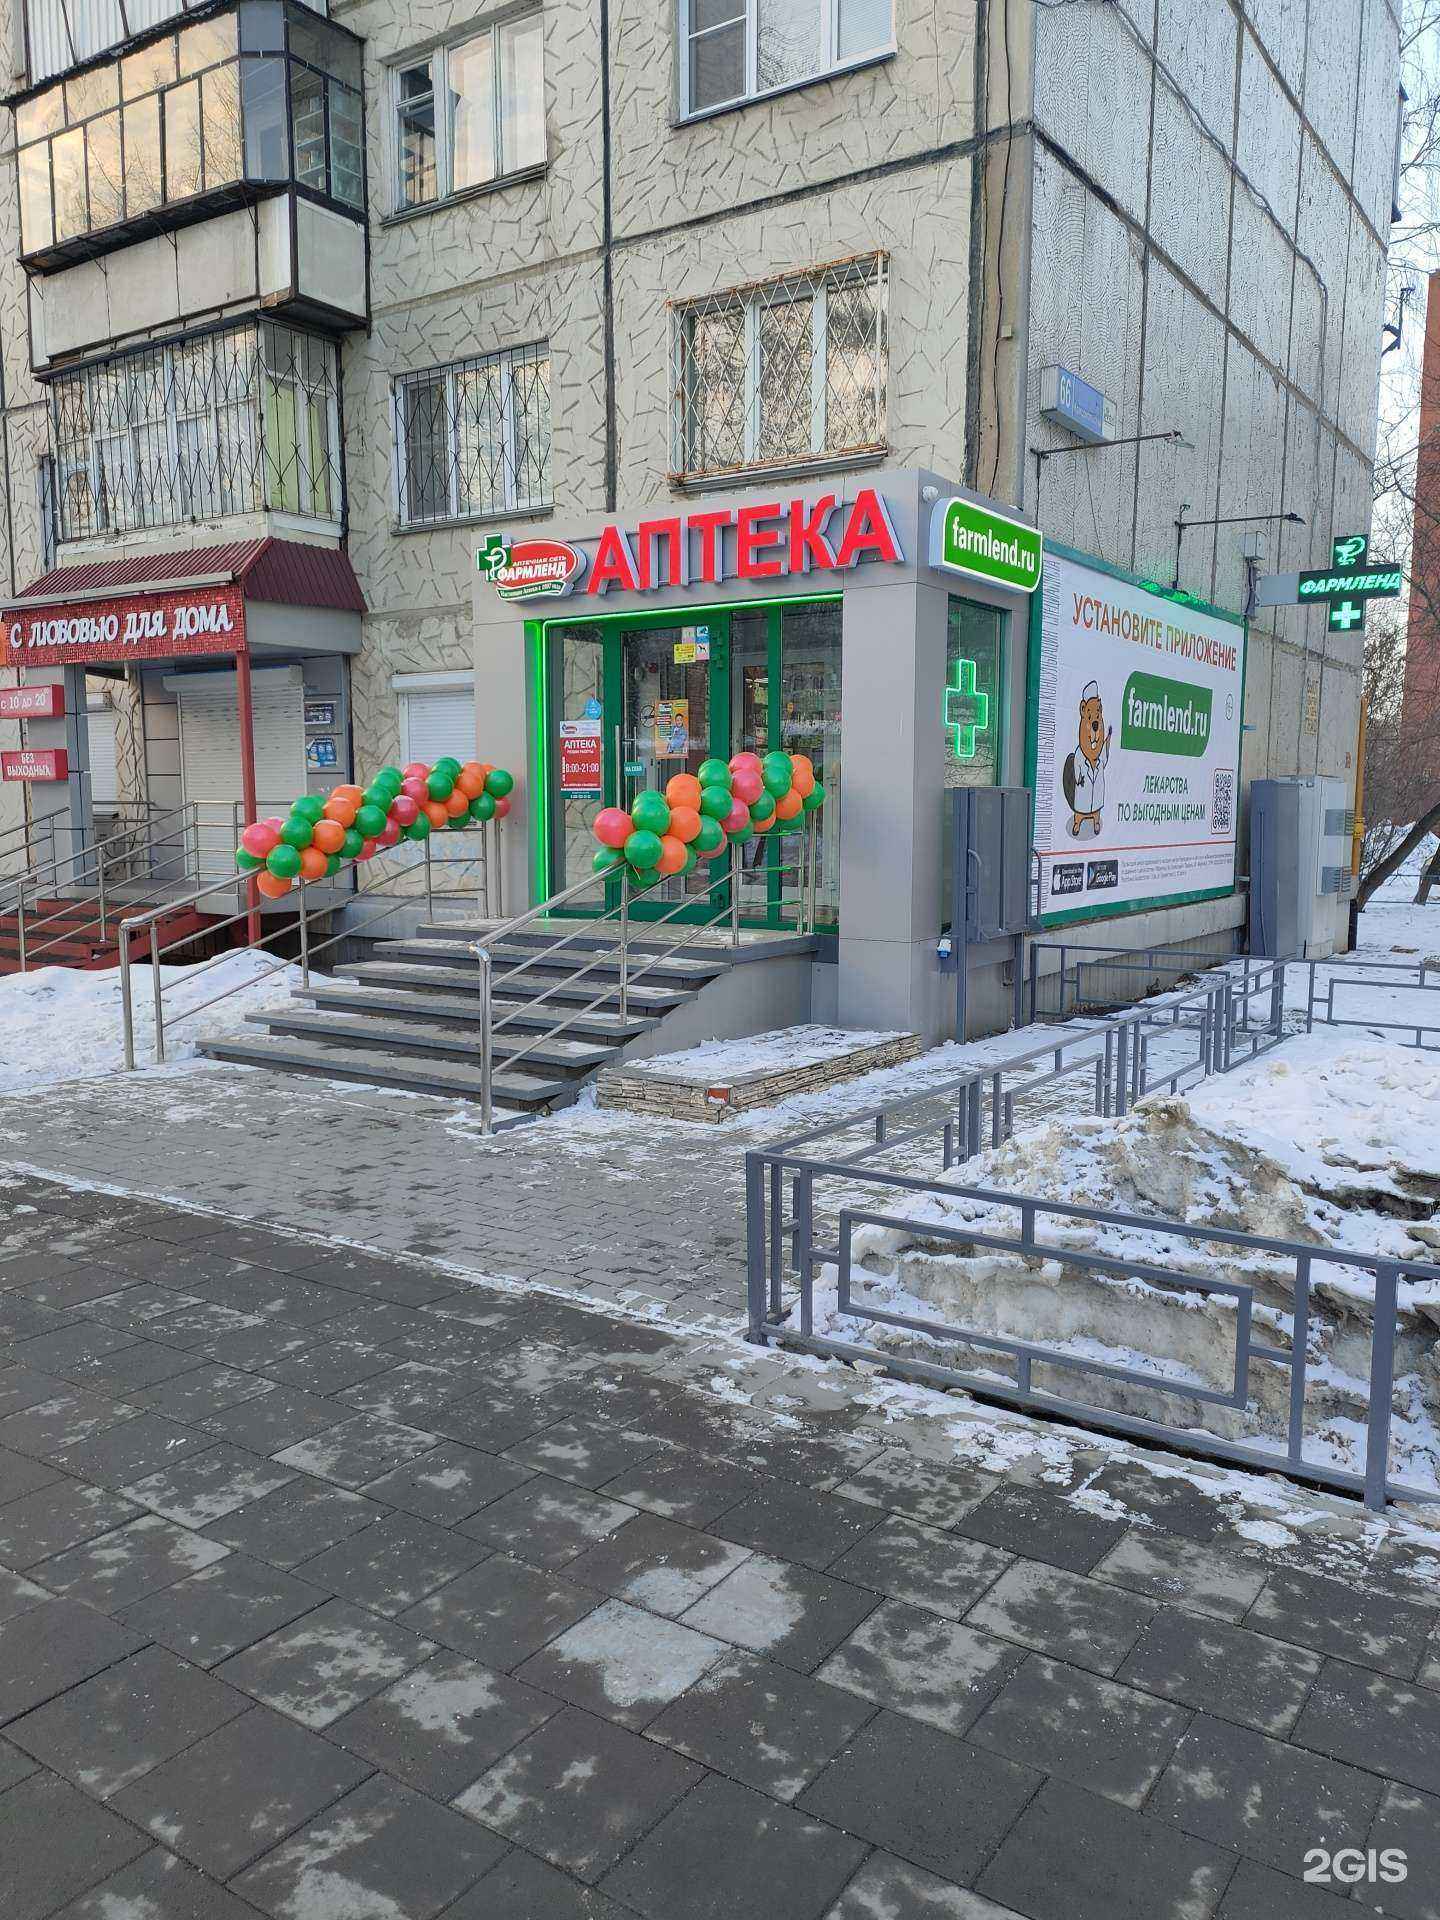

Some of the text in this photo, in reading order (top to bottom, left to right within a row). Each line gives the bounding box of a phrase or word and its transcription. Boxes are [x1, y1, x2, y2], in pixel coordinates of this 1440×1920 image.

[1060, 376, 1072, 408] 66
[587, 489, 904, 594] АПТЕКА
[953, 516, 1035, 572] farmlend.ru
[497, 561, 567, 581] ФАРМЛЕНД
[1300, 573, 1400, 594] ФАРМЛЕНД
[10, 604, 234, 648] С ЛЮБОВЬЮ ДЛЯ ДОМА
[1072, 592, 1237, 672] УСТАНОВИТЕ ПРИЛОЖЕНИЕ
[1128, 687, 1208, 737] farmlend.ru
[564, 739, 597, 749] АПТЕКА
[21, 753, 35, 764] БЕЗ
[565, 762, 599, 773] 8:00-21:00
[7, 764, 51, 777] ВЫХОДНЫХ
[1143, 775, 1189, 794] ЛЕКАРСТВА
[1117, 803, 1206, 824] ПО ВЫГОДНЫМ ЦЕНАМ
[1061, 874, 1082, 890] App Store
[1096, 871, 1117, 885] Google Play
